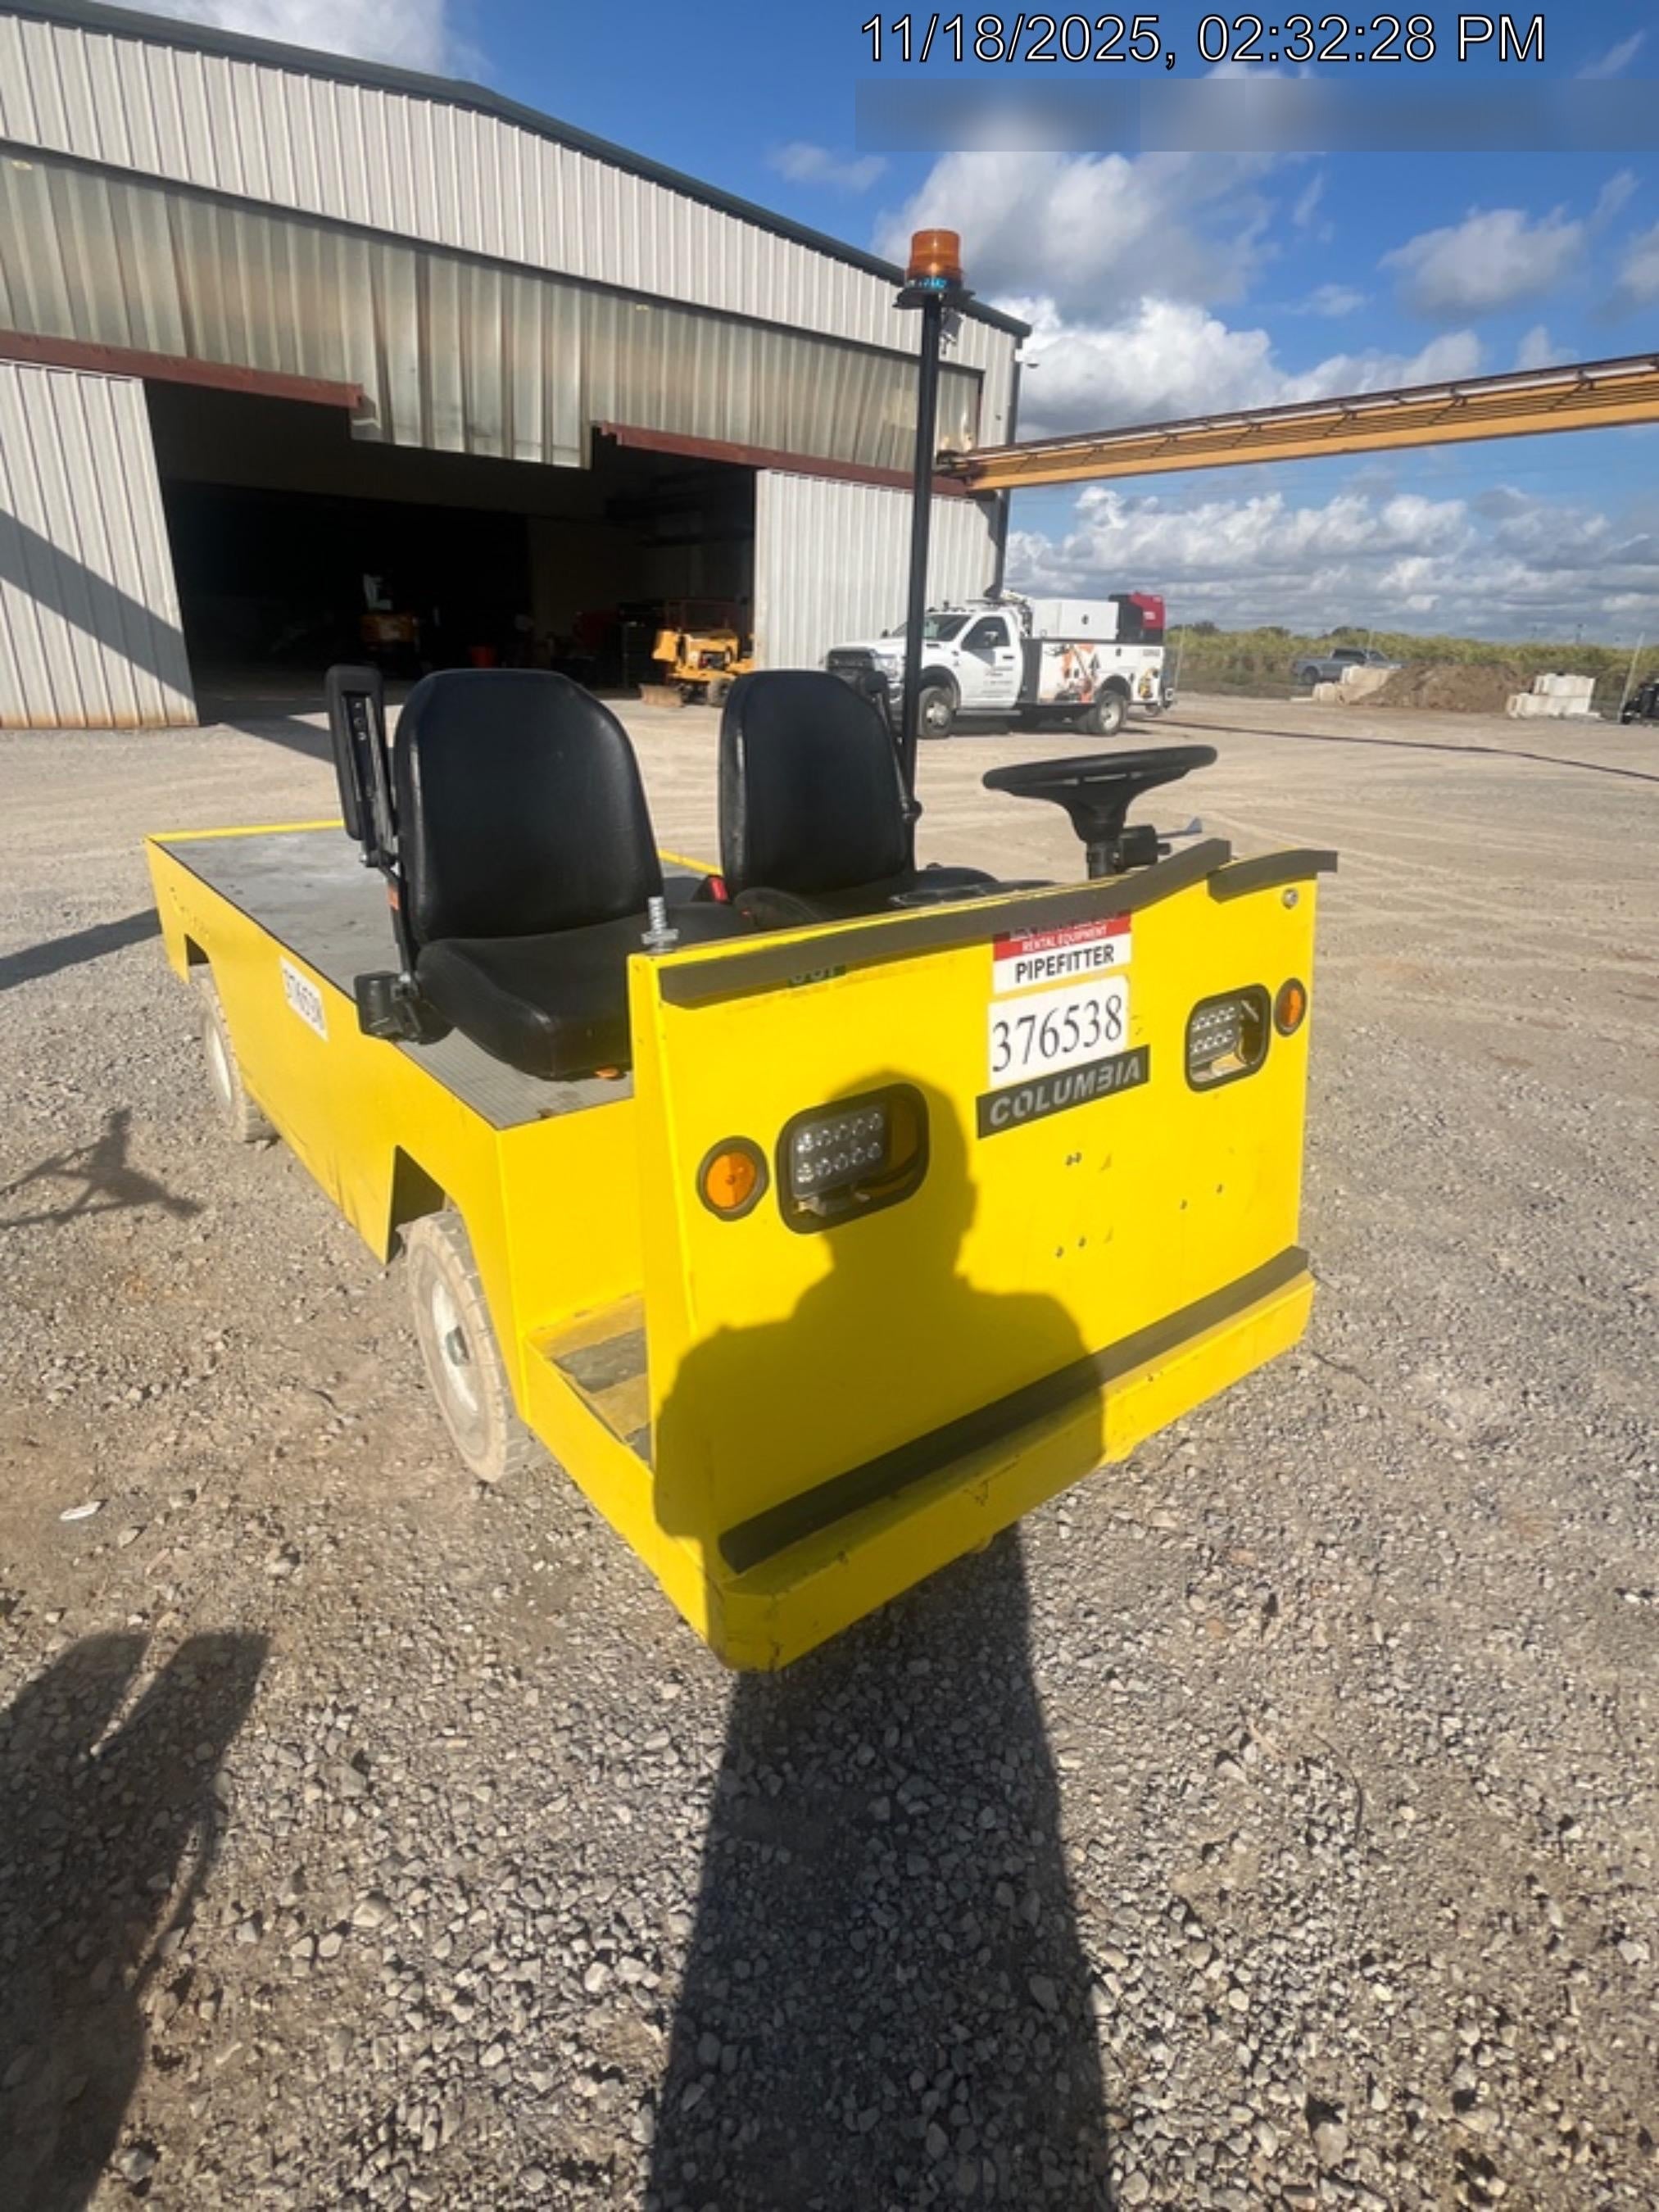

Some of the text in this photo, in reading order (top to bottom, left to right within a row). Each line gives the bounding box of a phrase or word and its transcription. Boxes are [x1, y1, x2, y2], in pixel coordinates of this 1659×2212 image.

[1015, 944, 1115, 983] PIPEFITTER
[992, 994, 1122, 1073] 376538
[989, 1055, 1142, 1127] COLUMBIA
